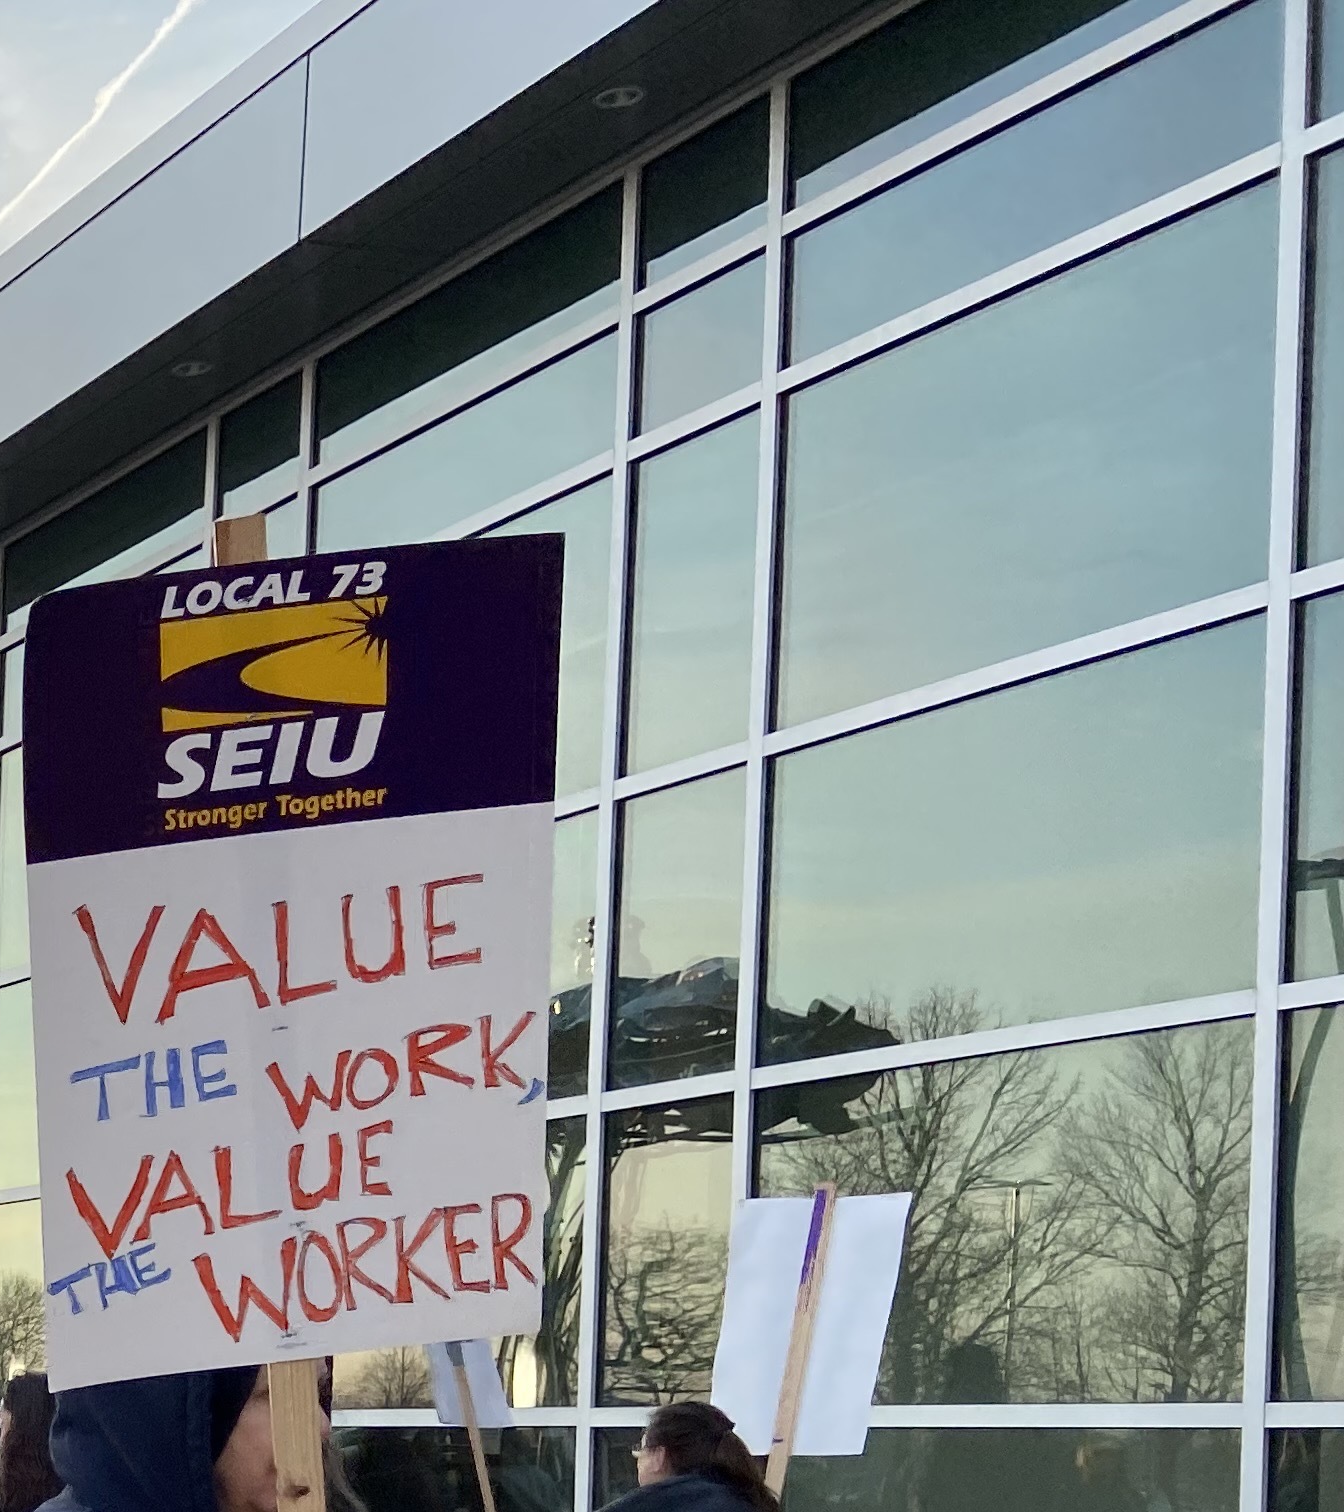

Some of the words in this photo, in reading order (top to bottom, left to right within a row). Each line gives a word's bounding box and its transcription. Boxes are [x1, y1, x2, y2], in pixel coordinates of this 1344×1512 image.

[160, 569, 311, 619] LOCAL
[328, 561, 387, 600] 73
[157, 710, 385, 799] SEIU
[164, 800, 268, 831] Stronger
[275, 787, 387, 819] Together
[74, 873, 483, 1026] VALUE
[69, 1039, 237, 1122] THE
[265, 1010, 546, 1131] WORK,
[66, 1120, 393, 1260] VALUE
[47, 1242, 173, 1316] THE
[192, 1193, 538, 1344] WORKER
